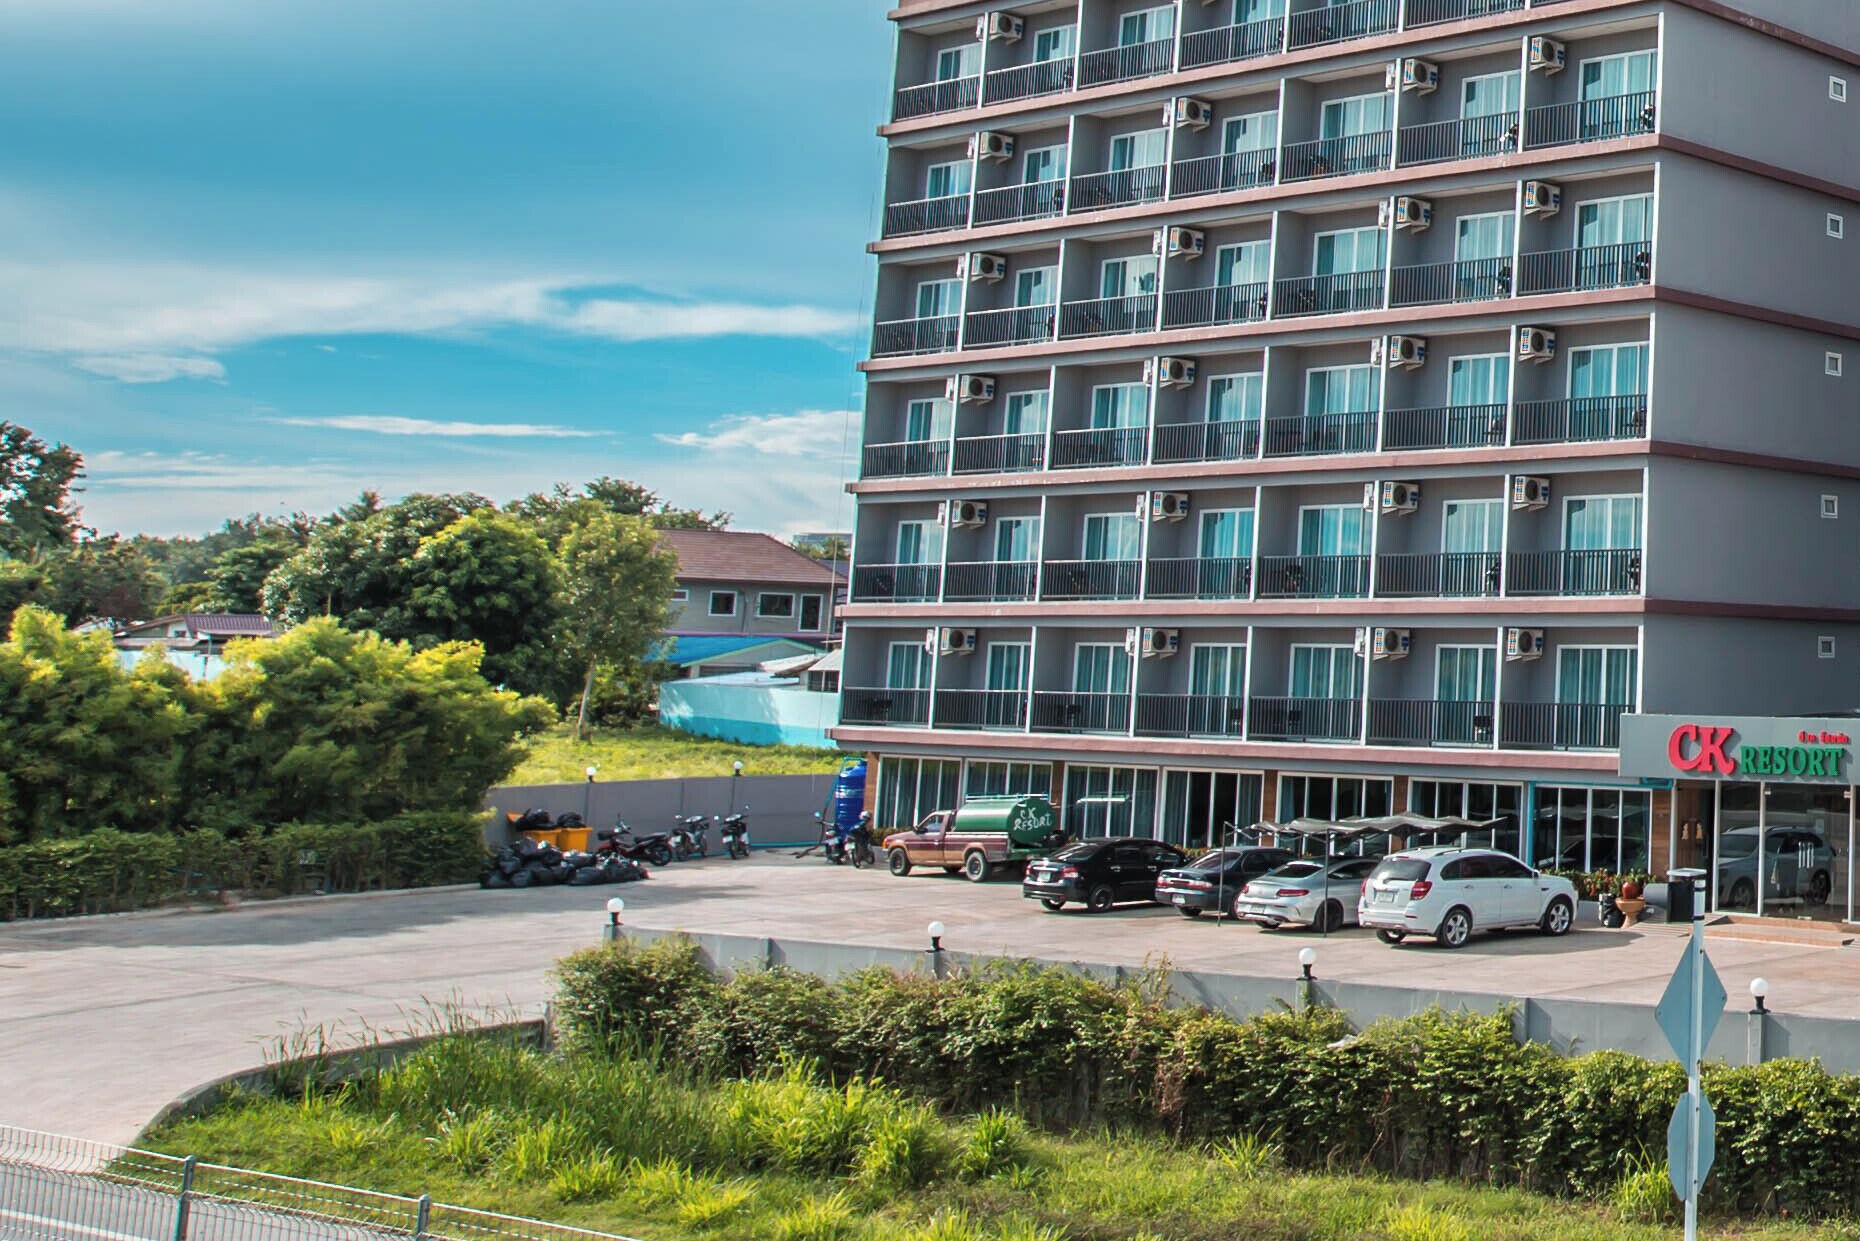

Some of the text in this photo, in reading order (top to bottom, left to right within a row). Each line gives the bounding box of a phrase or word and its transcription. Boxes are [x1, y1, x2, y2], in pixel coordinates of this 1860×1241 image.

[1668, 723, 1845, 777] CK RESORT
[1013, 812, 1052, 831] RESORT
[1020, 807, 1036, 820] CK
